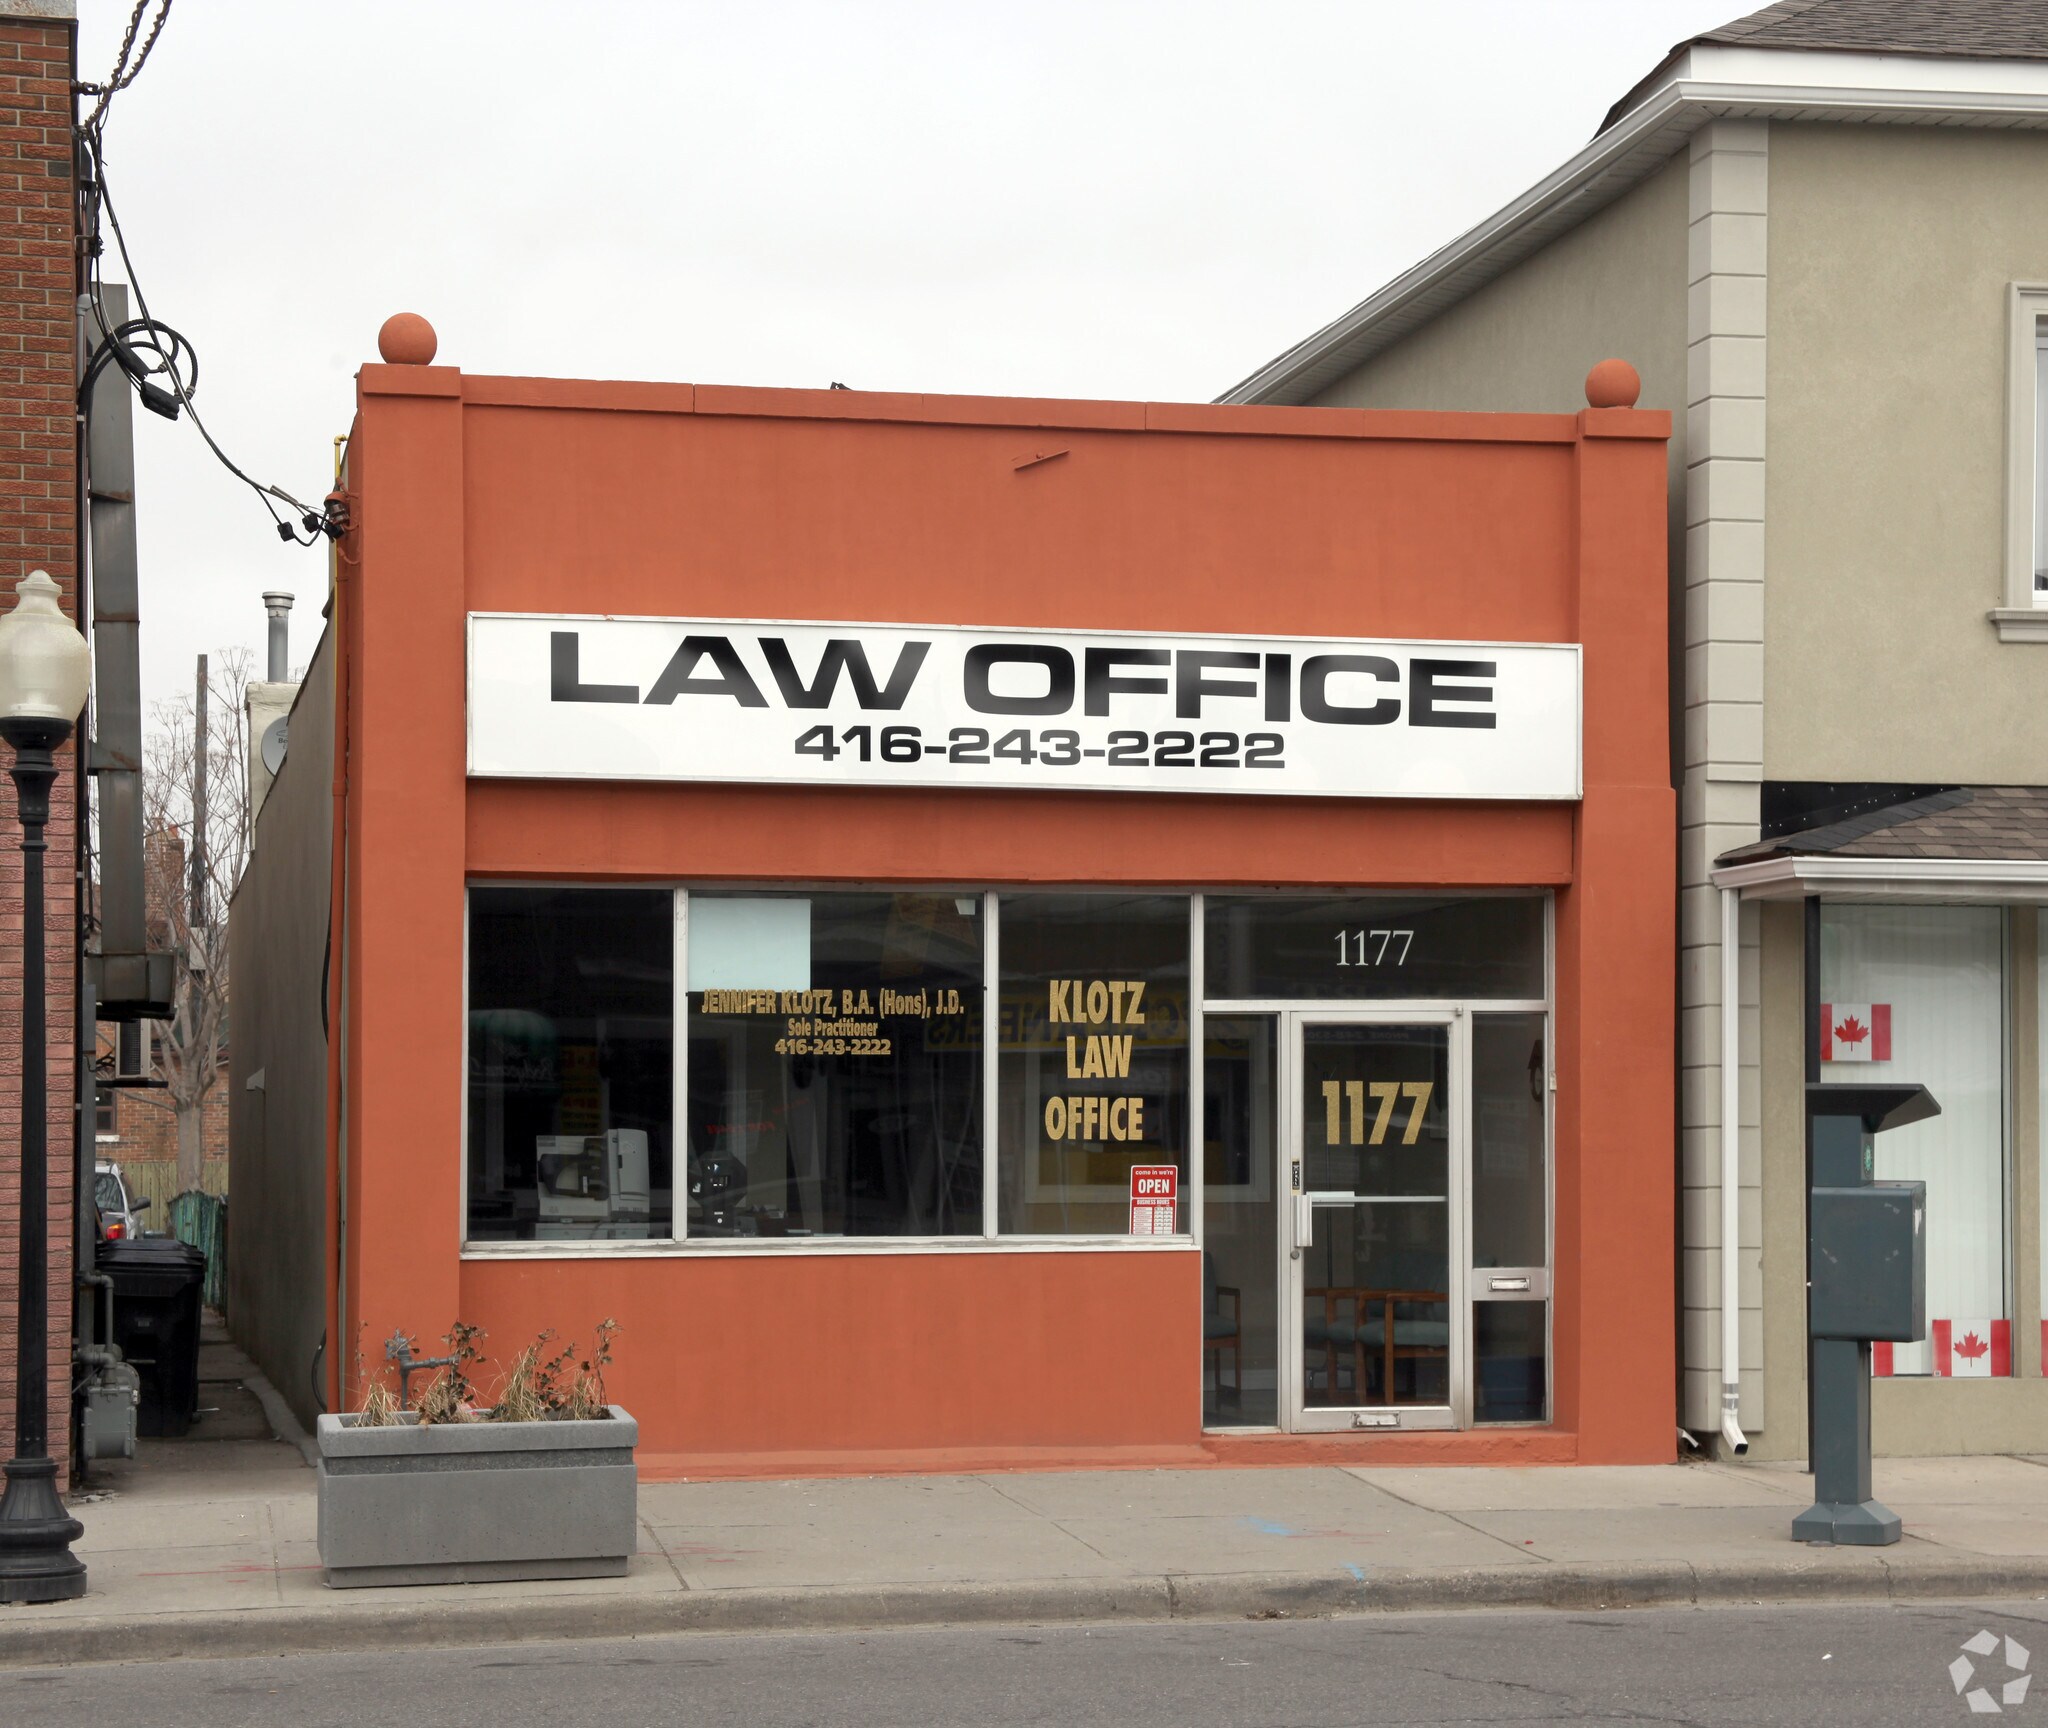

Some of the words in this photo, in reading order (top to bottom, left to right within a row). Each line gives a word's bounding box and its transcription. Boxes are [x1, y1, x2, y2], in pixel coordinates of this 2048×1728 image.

[551, 631, 932, 710] LAW
[964, 644, 1496, 729] OFFICE
[795, 725, 1285, 768] 416-243-2222
[1334, 929, 1414, 966] 1177
[702, 989, 776, 1014] JENNIFER
[781, 989, 836, 1017] KLOTZ,
[842, 989, 874, 1014] B.A.
[880, 988, 931, 1019] (Hons),
[935, 989, 964, 1014] J.D.
[1050, 980, 1146, 1024] KLOTZ
[775, 1038, 891, 1055] 416-243-2222
[788, 1017, 811, 1036] Sole
[814, 1018, 878, 1037] Practitioner
[1066, 1035, 1133, 1078] LAW
[1045, 1096, 1144, 1141] OFFICE
[1322, 1080, 1433, 1145] 1177
[1138, 1179, 1169, 1194] OPEN
